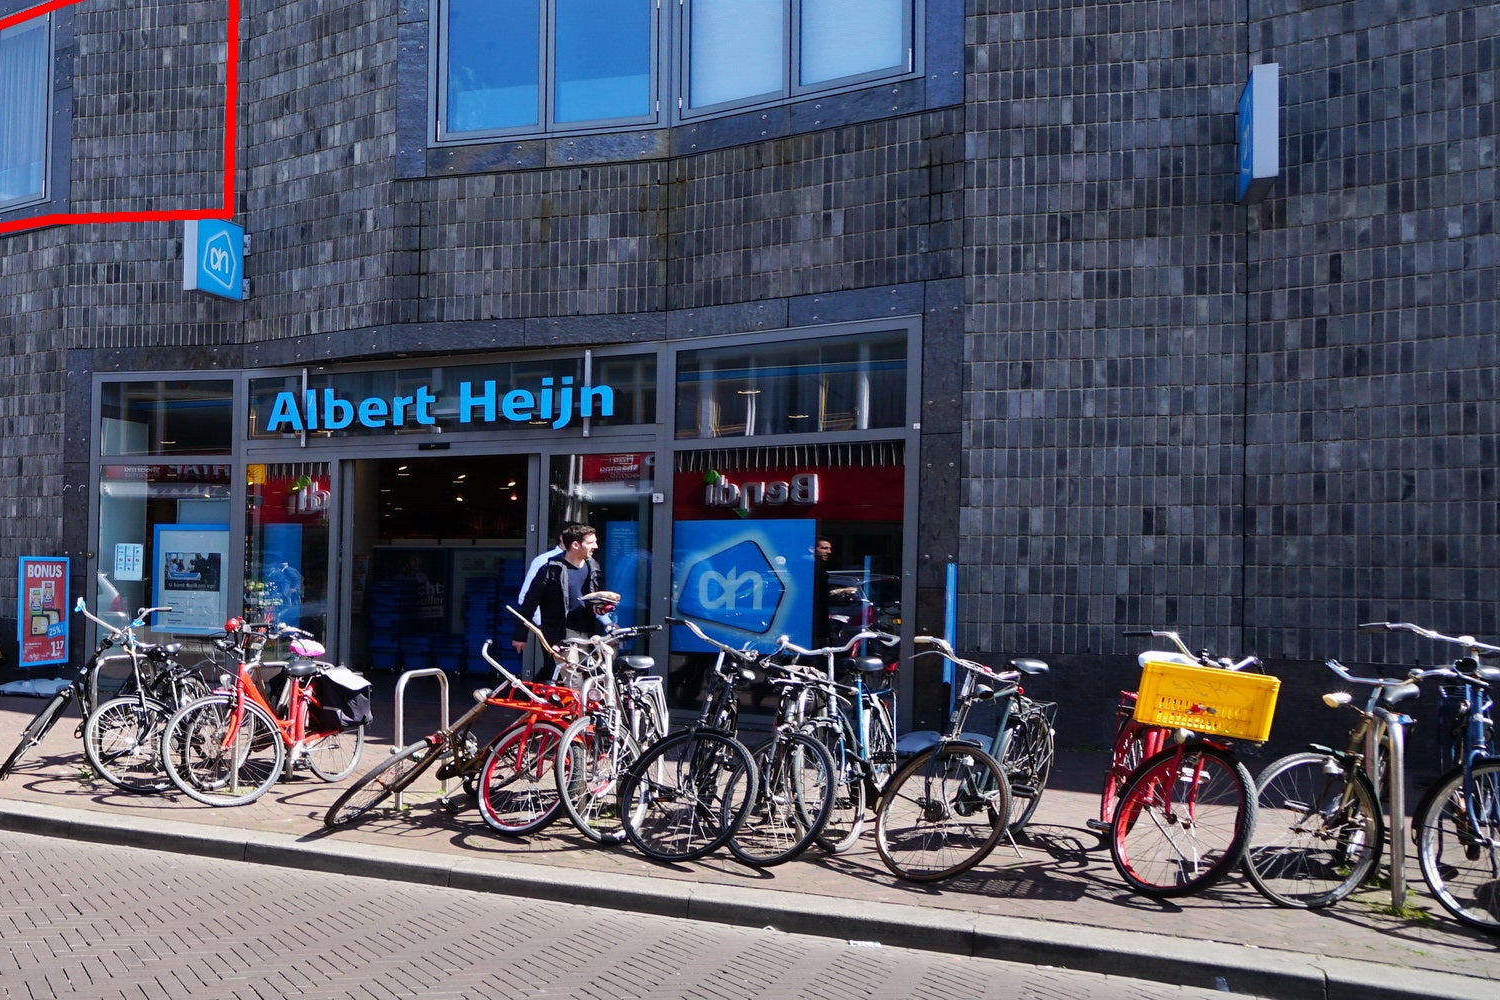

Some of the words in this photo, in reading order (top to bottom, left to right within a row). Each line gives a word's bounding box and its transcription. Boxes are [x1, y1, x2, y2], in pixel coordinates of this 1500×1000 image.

[267, 385, 436, 432] Albert
[460, 376, 614, 431] Heijn
[27, 564, 62, 578] BONUS
